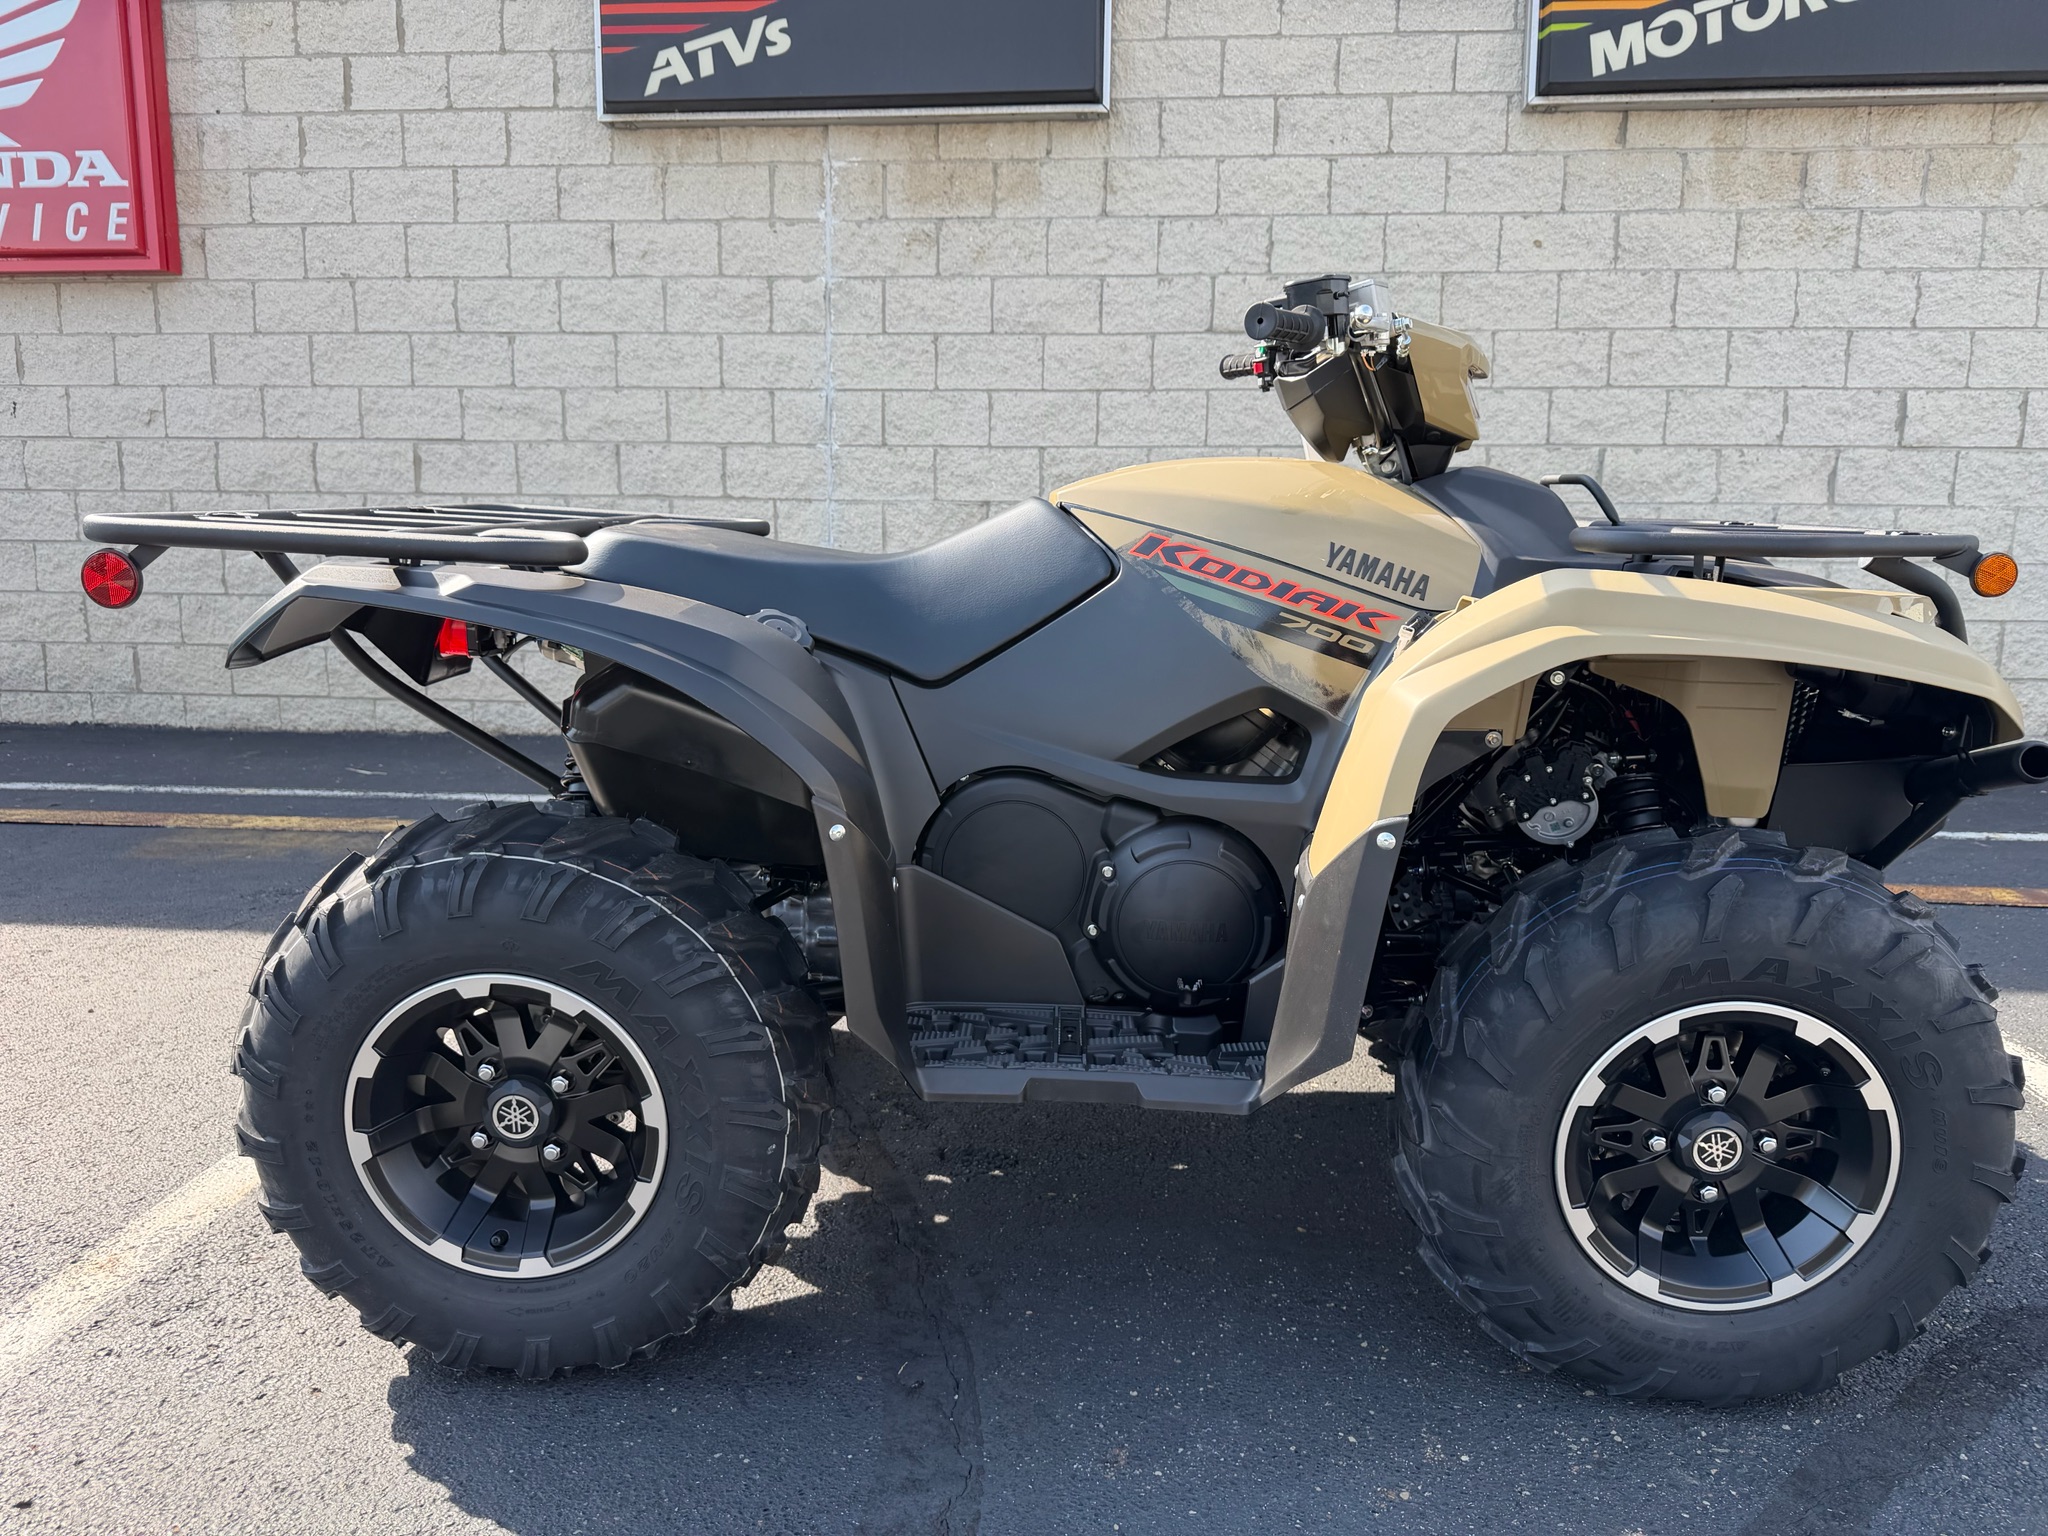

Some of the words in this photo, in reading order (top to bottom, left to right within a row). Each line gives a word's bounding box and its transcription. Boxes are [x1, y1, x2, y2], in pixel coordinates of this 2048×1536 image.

[644, 15, 792, 97] ATVs
[1127, 531, 1402, 634] KODIAK
[1325, 541, 1431, 601] YAMAHA
[1277, 612, 1376, 654] 700
[1143, 919, 1229, 943] YAMAHA
[1652, 956, 1943, 1091] MAXXIS
[560, 959, 713, 1217] MAXXIS
